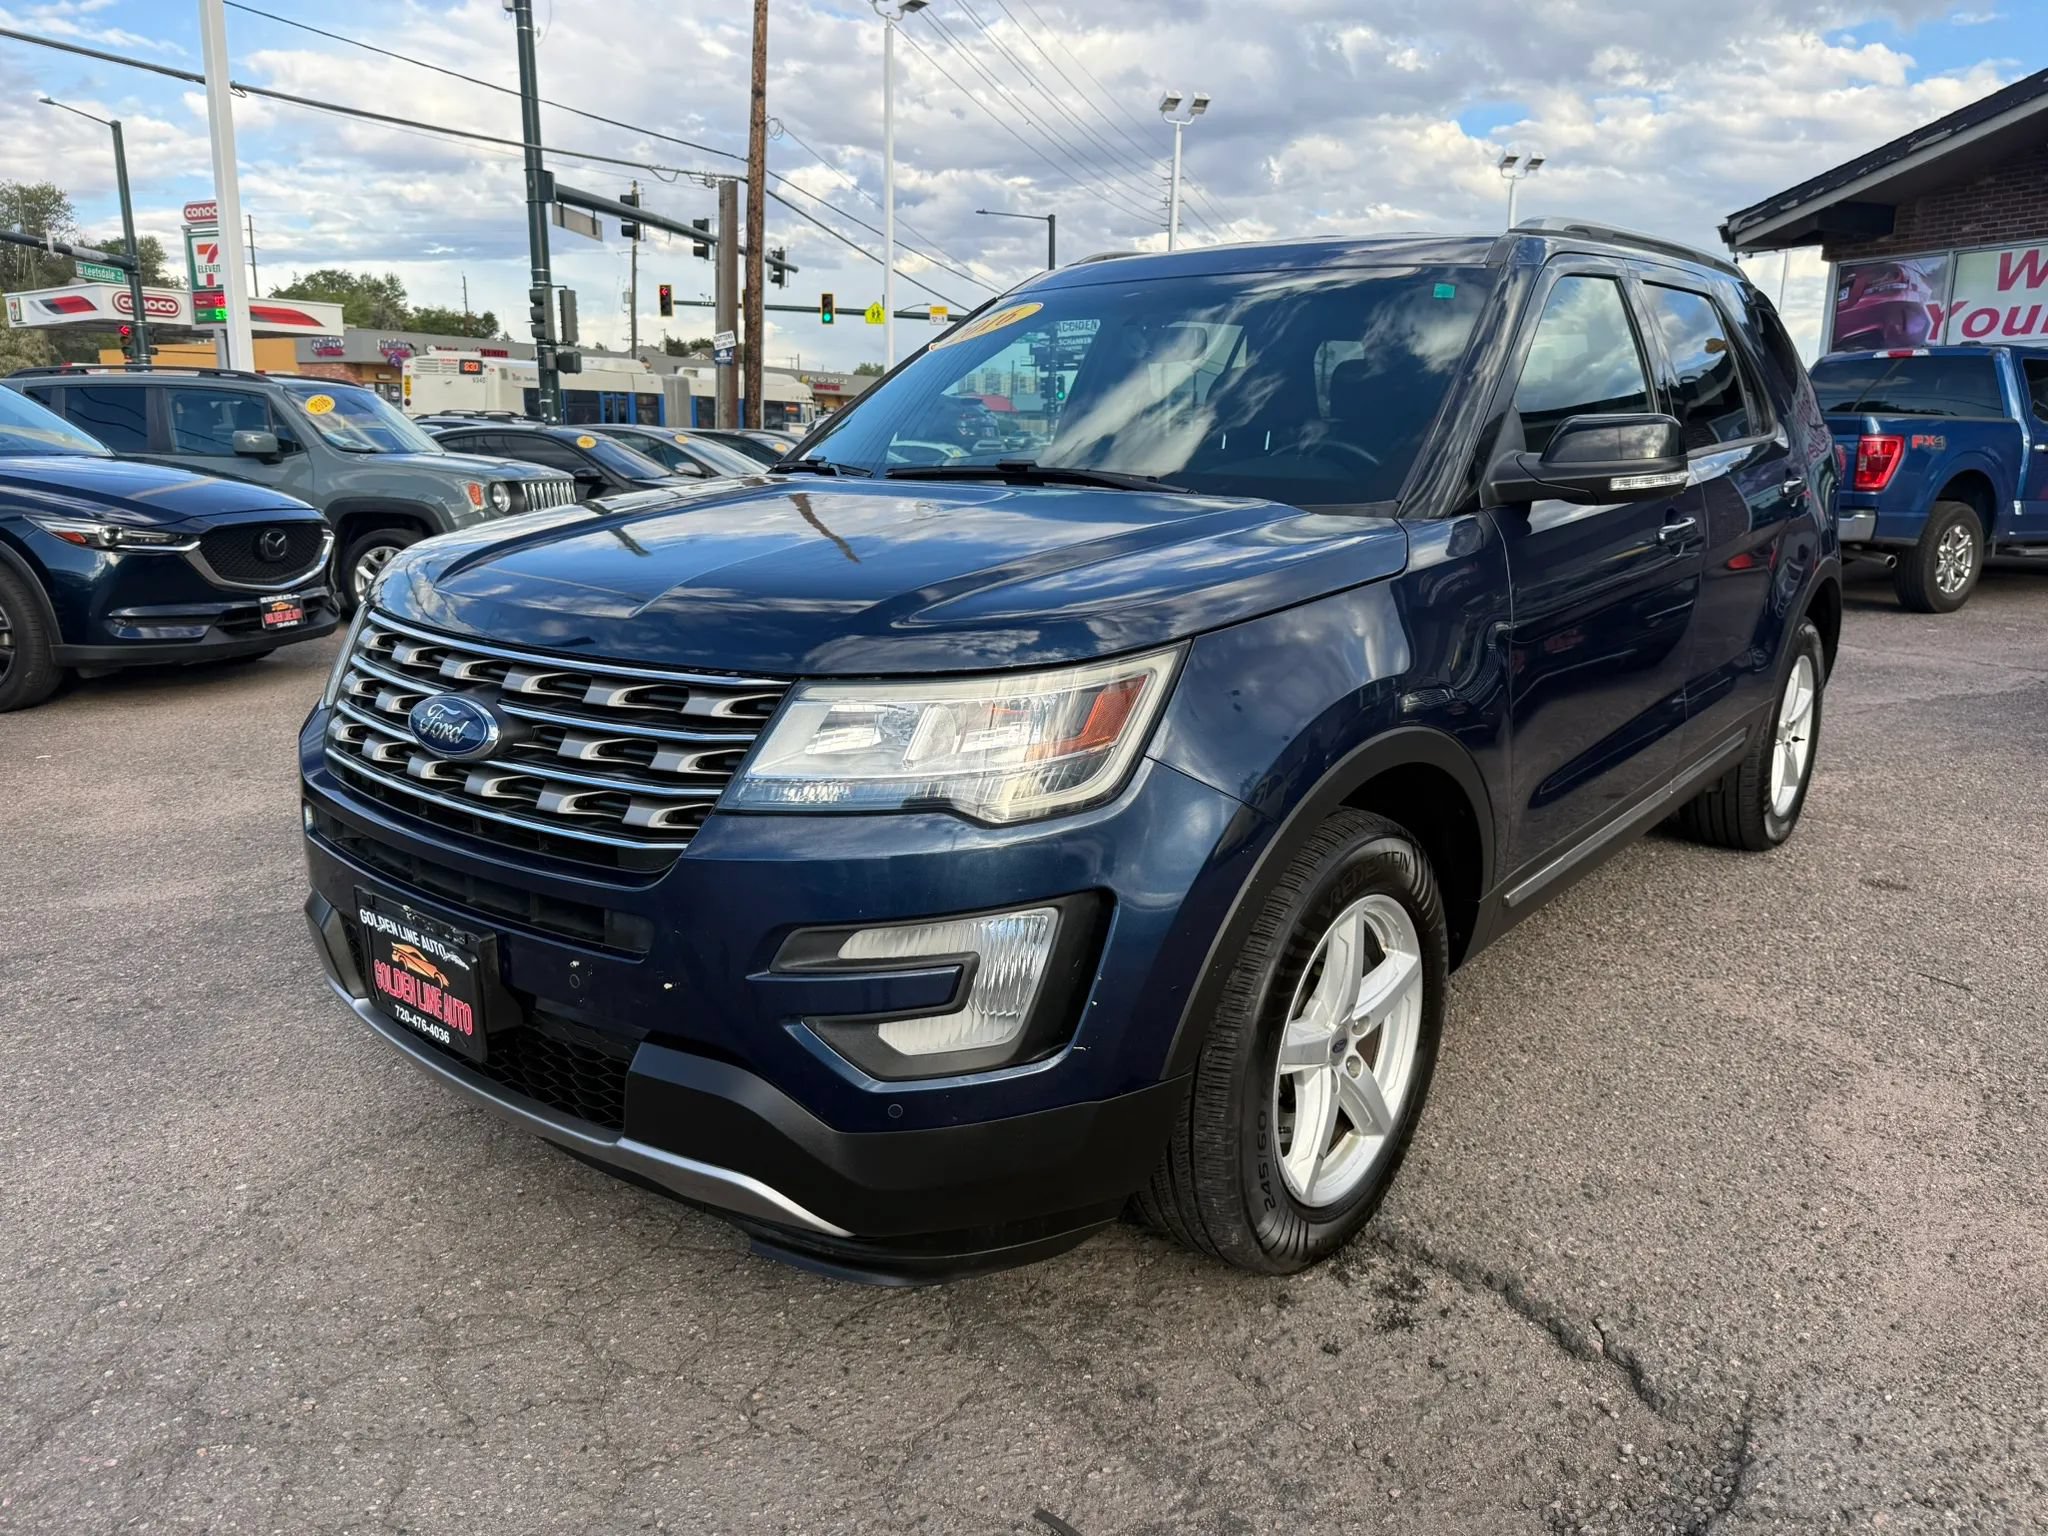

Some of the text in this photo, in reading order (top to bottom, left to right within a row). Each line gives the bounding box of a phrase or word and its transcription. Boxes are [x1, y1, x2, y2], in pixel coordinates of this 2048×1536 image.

[83, 266, 115, 280] Leetsdale
[420, 703, 470, 744] Ford
[359, 908, 446, 960] GOLDEN LINE AUTO
[374, 959, 473, 1036] GOLDEN LINE AUTO
[394, 1004, 450, 1044] 720-476-4036
